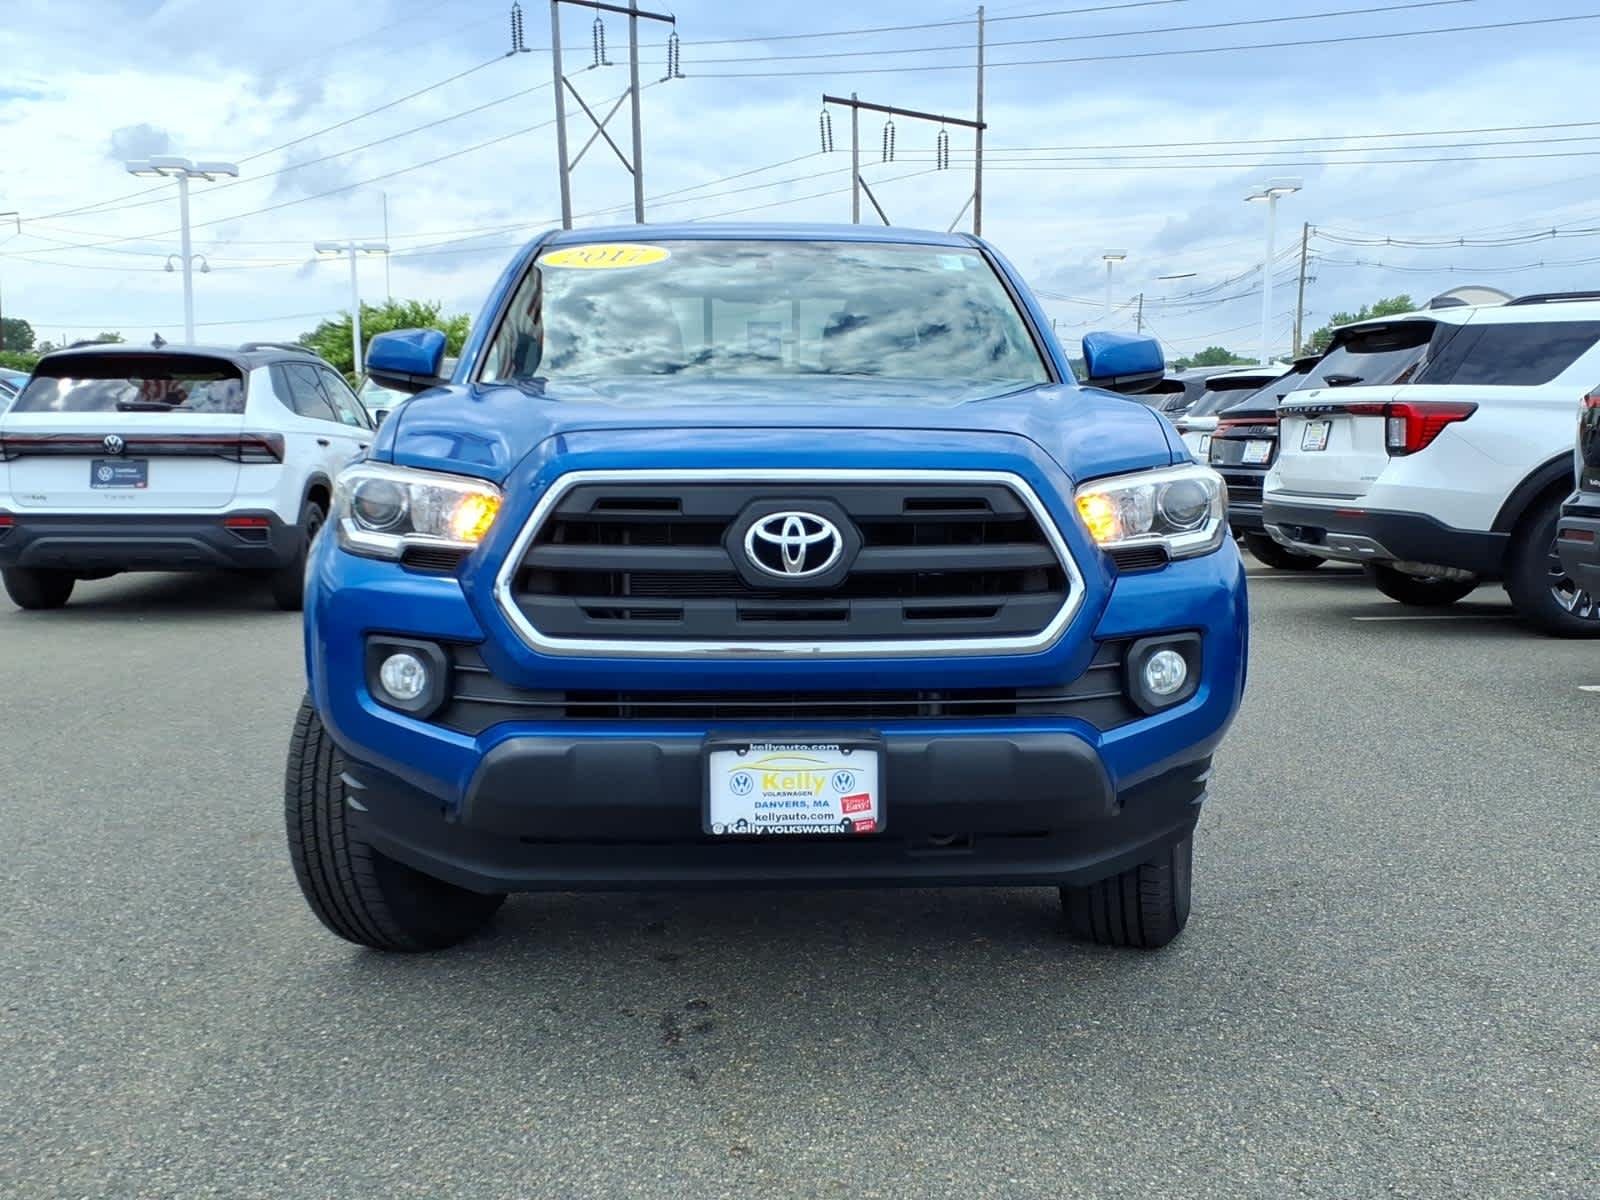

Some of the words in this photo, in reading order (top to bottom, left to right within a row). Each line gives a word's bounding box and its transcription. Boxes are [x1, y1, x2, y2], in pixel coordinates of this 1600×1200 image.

[749, 743, 840, 752] kellyauto.com
[761, 772, 826, 796] Kelly
[754, 801, 810, 809] DANVERS,
[813, 800, 830, 808] MA
[755, 812, 835, 822] kellyauto.com
[727, 823, 764, 835] Kelly
[769, 824, 845, 834] VOLKSWAGEN
